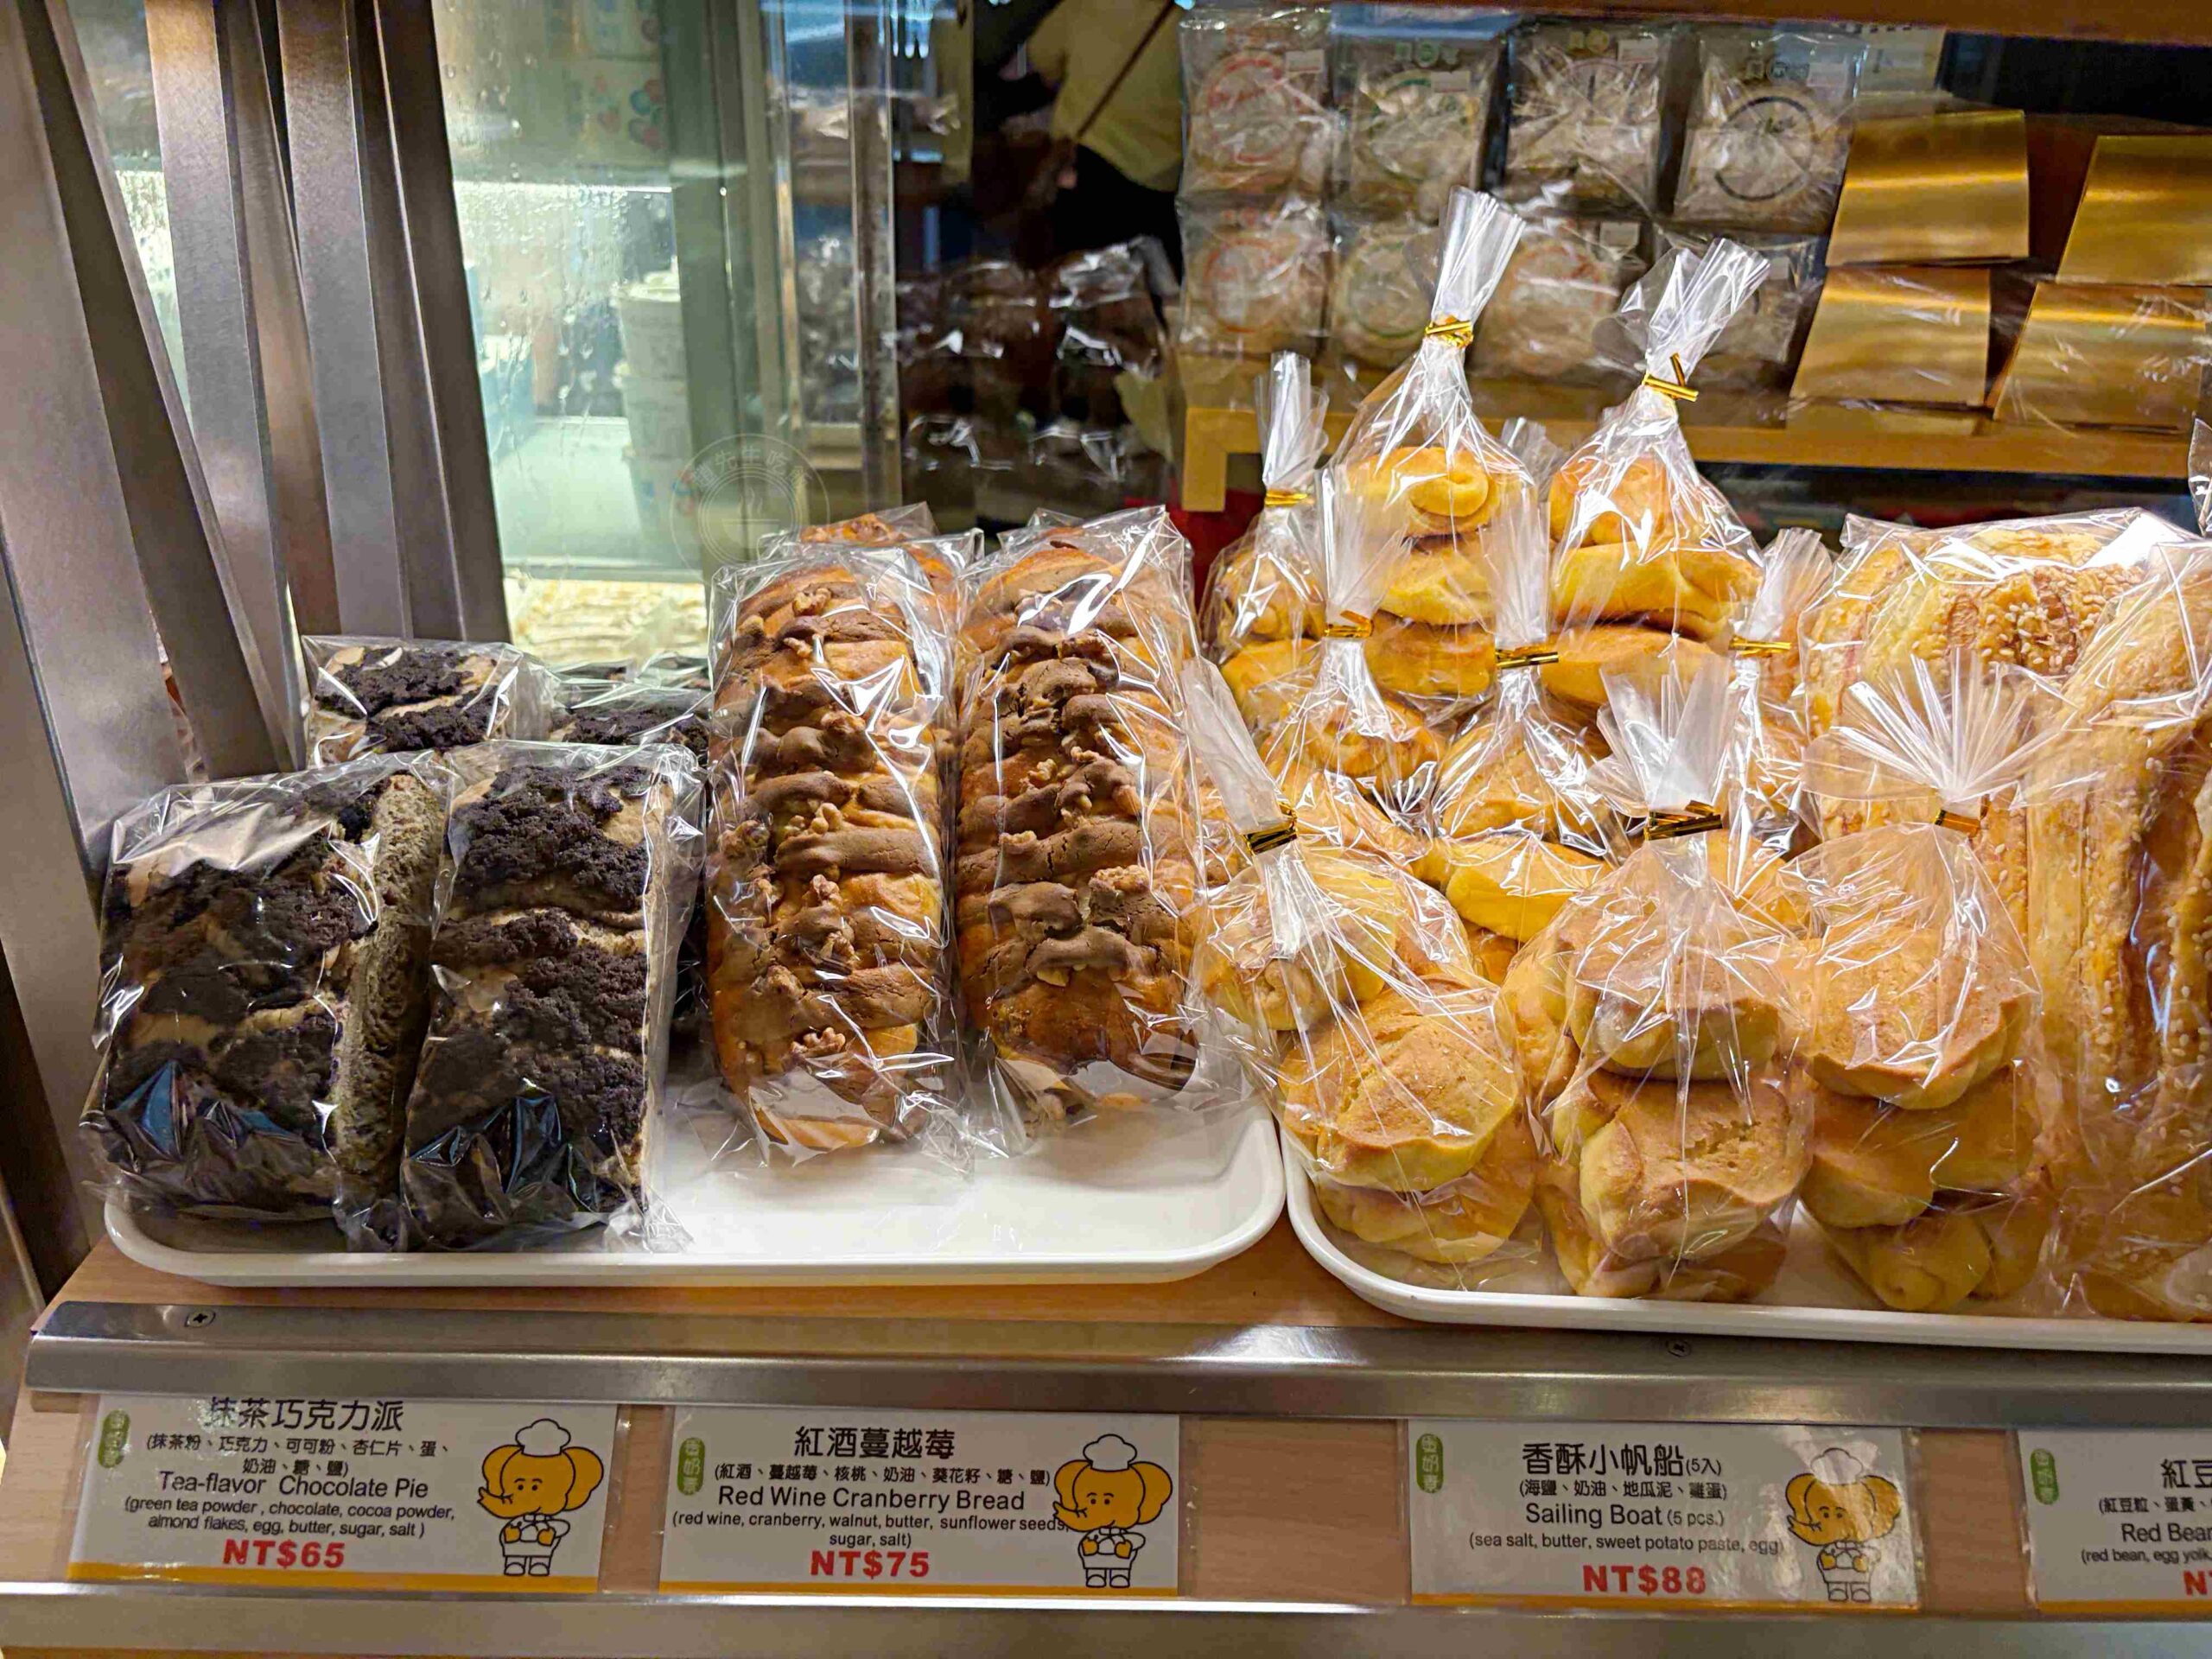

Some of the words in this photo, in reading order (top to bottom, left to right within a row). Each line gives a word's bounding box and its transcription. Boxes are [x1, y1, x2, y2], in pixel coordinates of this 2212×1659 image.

[794, 1427, 955, 1459] 紅酒蔓越莓
[159, 1470, 266, 1494] Tea-flavor
[279, 1475, 388, 1497] Chocolate
[395, 1478, 429, 1498] Pie
[125, 1496, 172, 1513] (green
[176, 1498, 198, 1511] tea
[270, 1501, 343, 1518] chocolate,
[347, 1504, 392, 1518] cocoa
[396, 1504, 455, 1521] powder,
[718, 1484, 764, 1506] Red
[771, 1485, 826, 1507] Wine
[833, 1487, 950, 1513] Cranberry
[957, 1490, 1025, 1510] Bread
[148, 1514, 200, 1529] almond
[204, 1516, 249, 1534] flakes,
[289, 1519, 336, 1536] butter,
[340, 1523, 385, 1539] sugar,
[672, 1511, 703, 1528] (red
[707, 1513, 745, 1527] wine,
[748, 1513, 825, 1529] cranberry,
[830, 1514, 881, 1529] walnut,
[886, 1515, 934, 1530] butter,
[940, 1516, 1016, 1530] sunflower
[1526, 1503, 1603, 1529] Sailing
[1611, 1503, 1663, 1525] Boat
[1688, 1510, 1725, 1527] pcs.)
[830, 1533, 876, 1548] sugar,
[880, 1533, 912, 1548] salt)
[1469, 1532, 1502, 1549] (sea
[1506, 1533, 1538, 1549] salt,
[1542, 1534, 1592, 1550] butter,
[1596, 1535, 1642, 1549] sweet
[1645, 1535, 1694, 1552] potato
[1698, 1536, 1745, 1553] paste,
[2121, 1522, 2162, 1542] Red
[223, 1538, 346, 1569] NT$65
[810, 1549, 930, 1580] NT$75
[2081, 1548, 2109, 1565] (red
[2113, 1548, 2150, 1563] bean,
[2153, 1550, 2180, 1565] egg
[1582, 1565, 1707, 1596] NT$88
[2183, 1569, 2212, 1596] N
